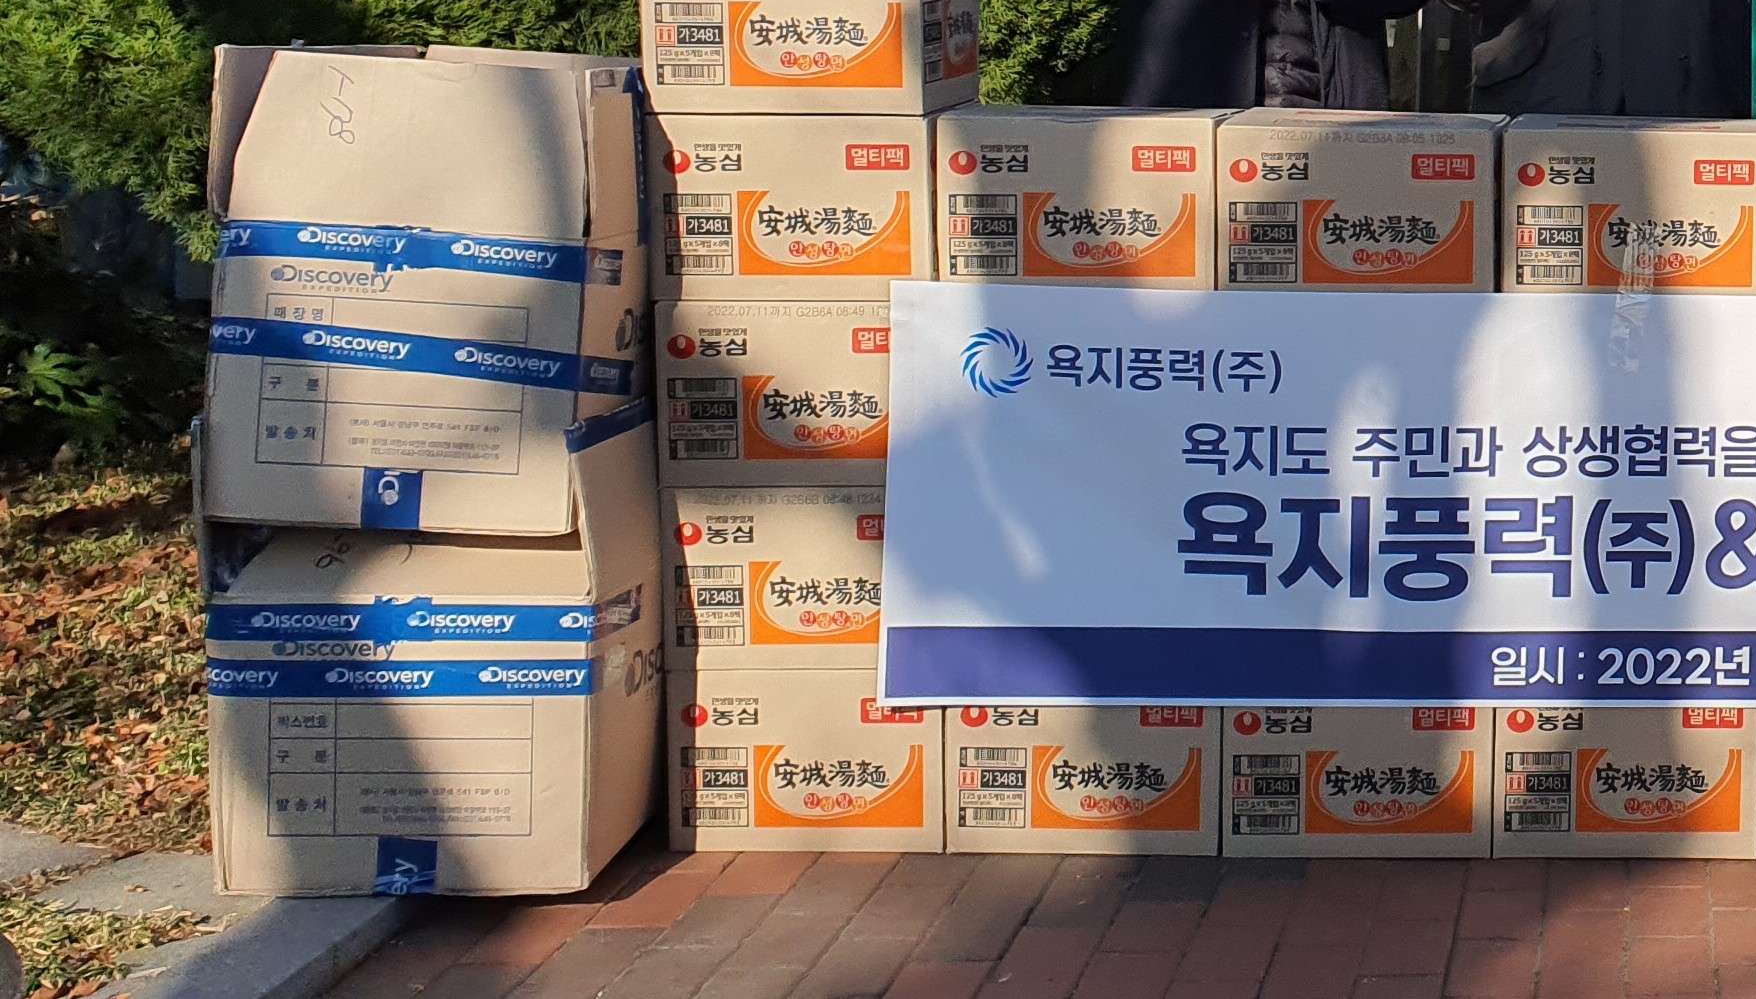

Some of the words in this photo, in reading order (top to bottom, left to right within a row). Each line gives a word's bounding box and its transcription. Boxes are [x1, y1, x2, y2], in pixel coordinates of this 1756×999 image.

[678, 29, 721, 42] 가3481
[694, 153, 742, 172] 농심
[851, 147, 904, 167] 멀티팩
[980, 154, 1029, 173] 농심
[1137, 149, 1191, 169] 멀티팩
[1417, 157, 1470, 176] 멀티팩
[1260, 162, 1309, 180] 농심
[1548, 166, 1595, 185] 농심
[1699, 162, 1750, 181] 멀티팩
[687, 219, 730, 233] 가3481
[972, 220, 1015, 234] 가3481
[305, 226, 407, 253] Discovery
[1539, 231, 1581, 244] 가3481
[460, 238, 558, 268] Discovery
[312, 330, 411, 360] Discovery
[699, 337, 748, 357] 농심
[465, 347, 561, 379] Discovery
[1046, 342, 1283, 396] 욕지풍력(주)
[1181, 423, 1330, 478] 욕지도
[1351, 425, 1502, 478] 주민과
[706, 524, 754, 544] 농심
[699, 591, 741, 605] 가3481
[259, 611, 361, 632] Discovery
[416, 611, 515, 632] Discovery
[1491, 646, 1565, 686] 일시
[1598, 646, 1751, 686] 2022년
[335, 668, 434, 689] Discovery
[487, 667, 587, 688] Discovery
[711, 707, 759, 726] 농심
[991, 708, 1039, 726] 농심
[1264, 715, 1312, 734] 농심
[1536, 712, 1583, 731] 농심
[704, 772, 746, 786] 가3481
